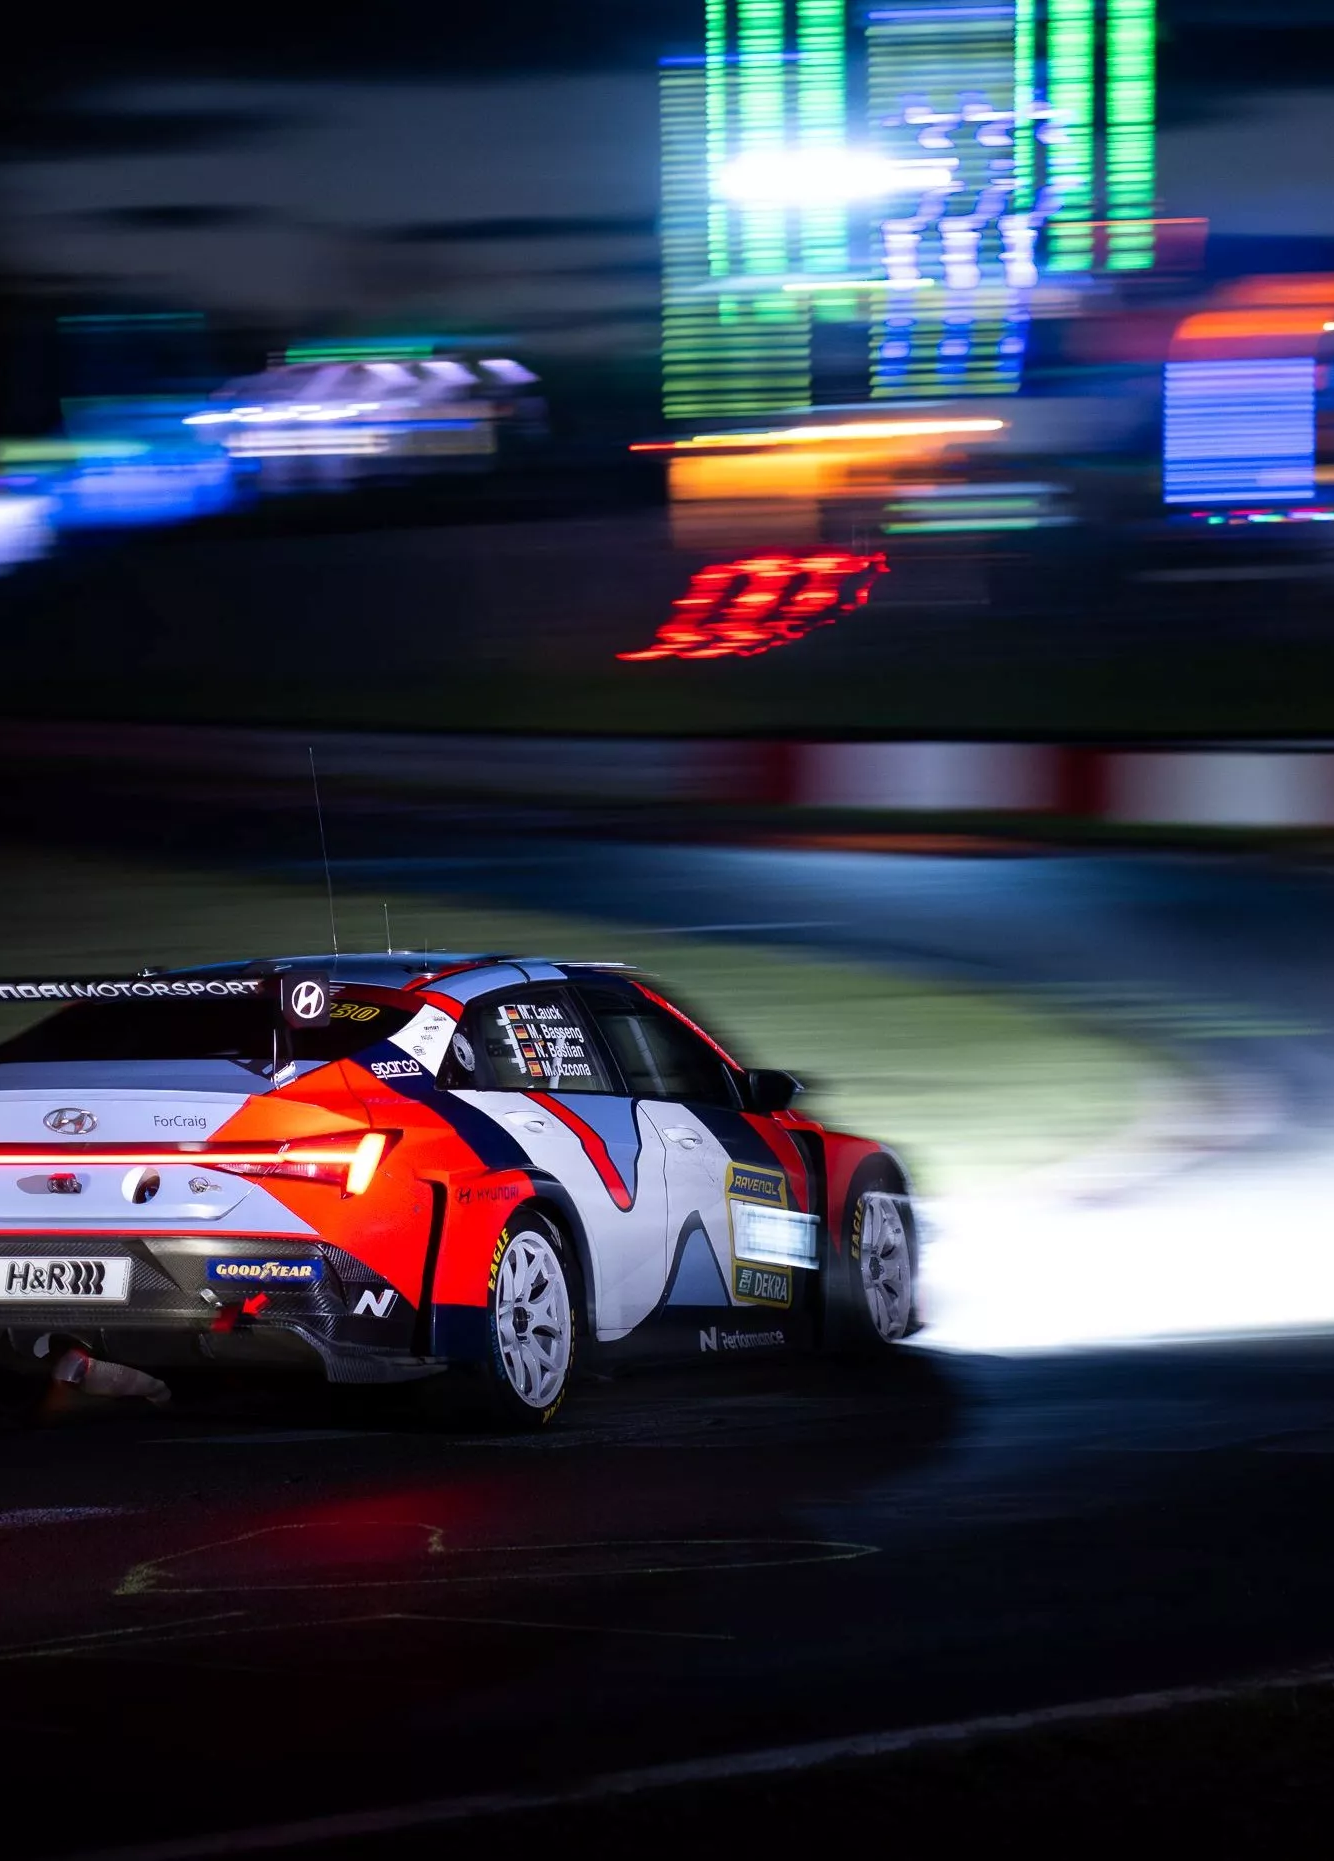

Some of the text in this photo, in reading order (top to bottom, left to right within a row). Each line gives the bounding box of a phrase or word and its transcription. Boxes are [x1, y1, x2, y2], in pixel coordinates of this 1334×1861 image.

[70, 980, 259, 997] MOTORSPORT
[330, 1003, 381, 1022] 30
[531, 1004, 564, 1020] Lauck
[527, 1023, 585, 1044] M. Basseng
[546, 1041, 585, 1058] Bastian
[370, 1058, 421, 1079] sparco
[558, 1062, 592, 1077] Azcona
[153, 1115, 207, 1130] ForCraig
[734, 1175, 779, 1196] RAVENOL
[488, 1227, 511, 1292] EAGLE
[6, 1259, 67, 1293] H&R
[216, 1261, 313, 1280] GOODYEAR
[754, 1272, 788, 1301] DEKRA
